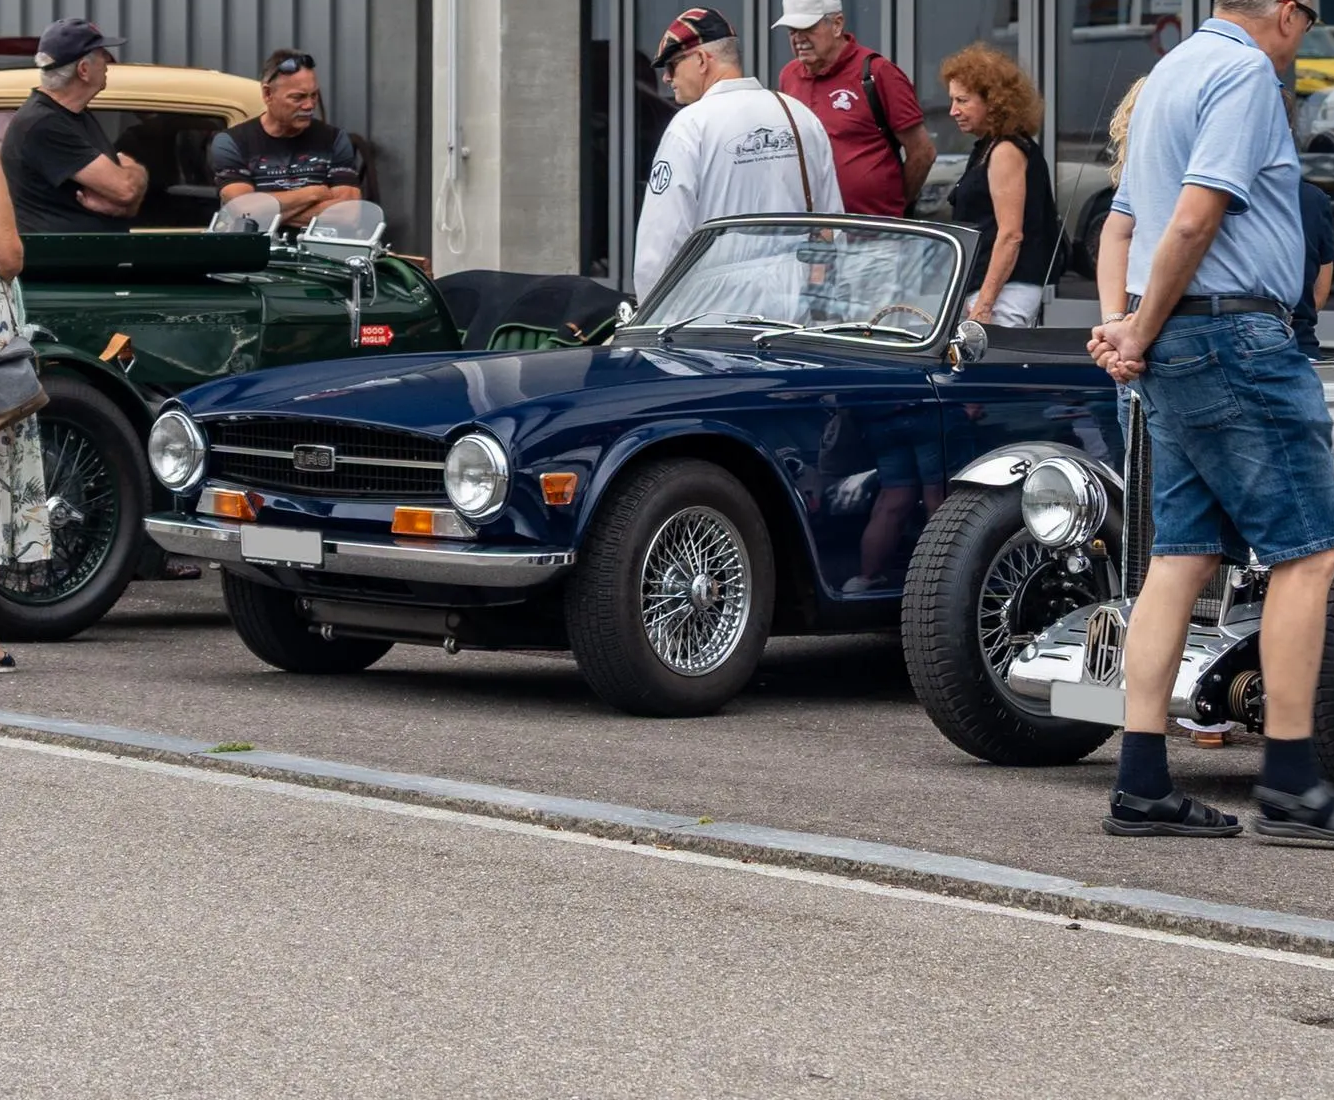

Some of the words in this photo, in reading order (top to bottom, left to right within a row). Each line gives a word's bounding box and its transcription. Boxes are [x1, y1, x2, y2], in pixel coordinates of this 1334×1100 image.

[649, 162, 670, 193] MG
[363, 327, 384, 335] 1000
[1087, 608, 1124, 686] MG
